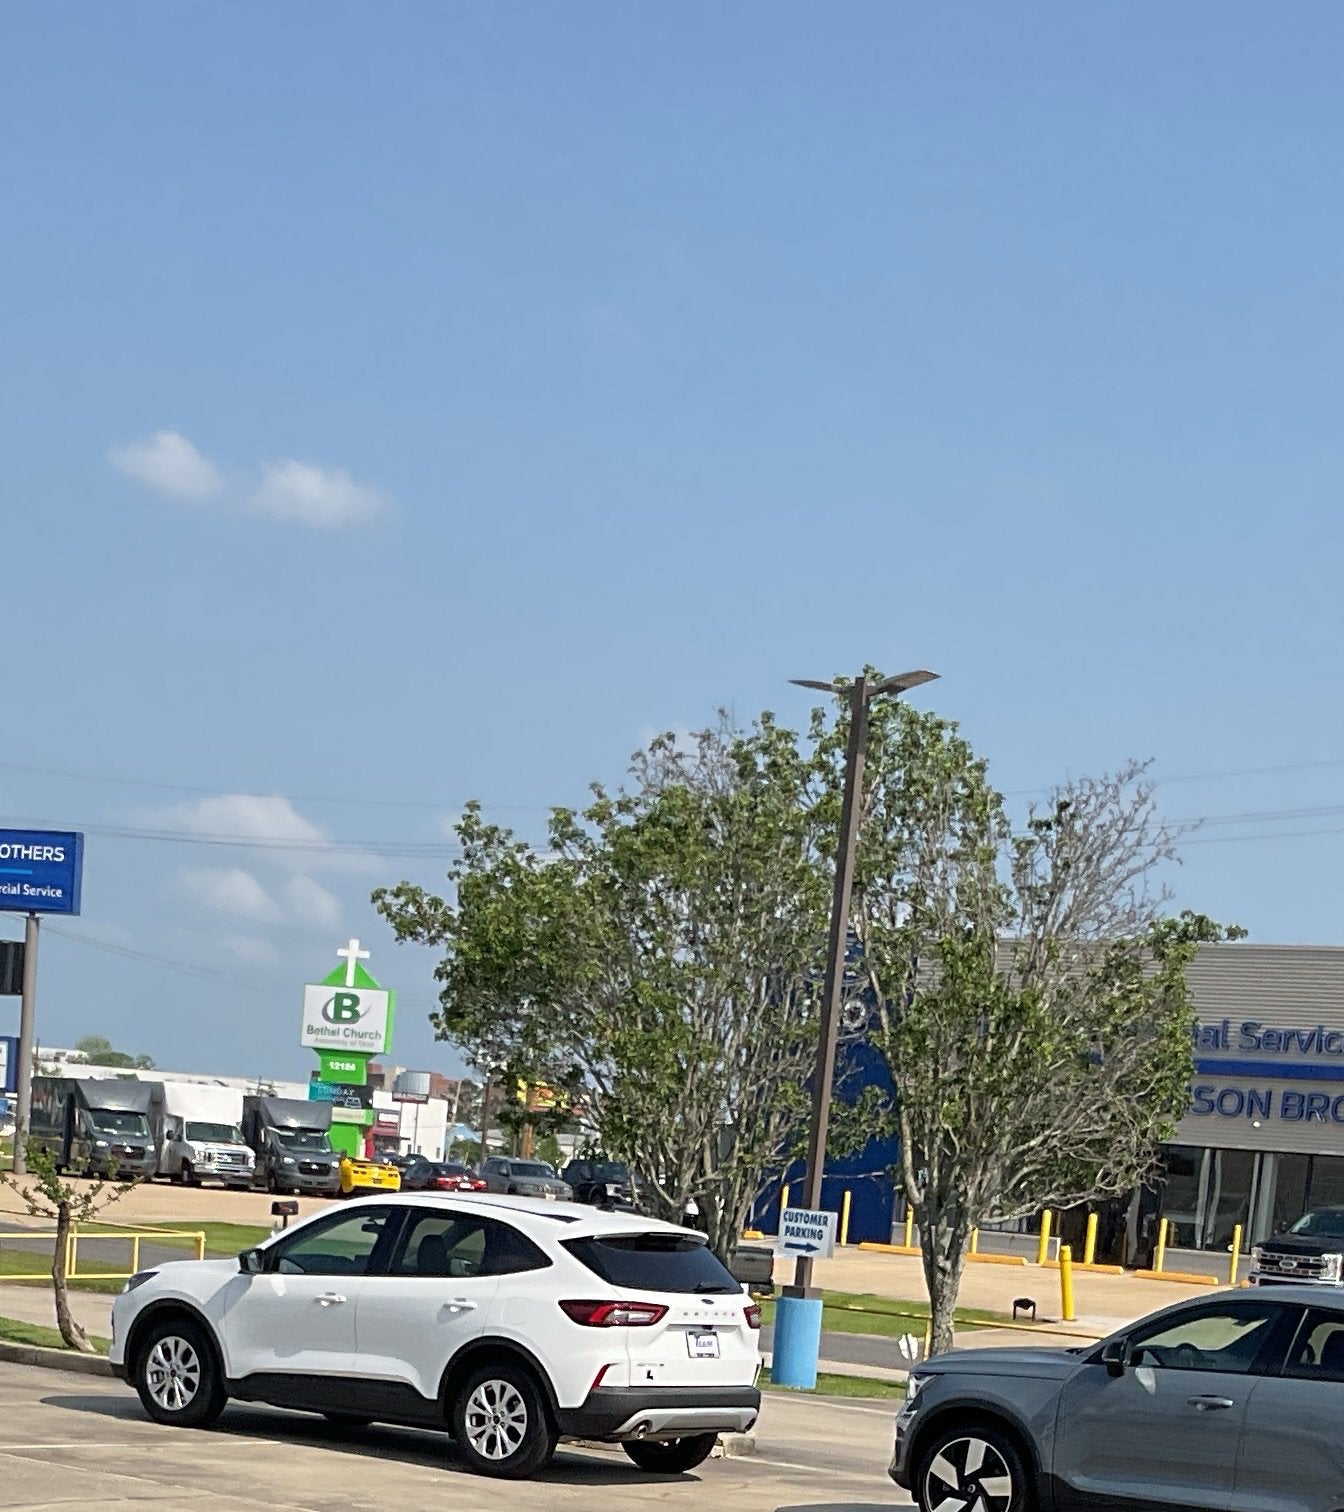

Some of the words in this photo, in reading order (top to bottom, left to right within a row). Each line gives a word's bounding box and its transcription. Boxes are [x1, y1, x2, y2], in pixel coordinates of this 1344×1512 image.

[23, 884, 63, 898] Service
[307, 1024, 340, 1036] Bethel
[343, 1027, 382, 1040] Church
[783, 1211, 829, 1227] CUSTOMER
[785, 1225, 824, 1240] PARKING
